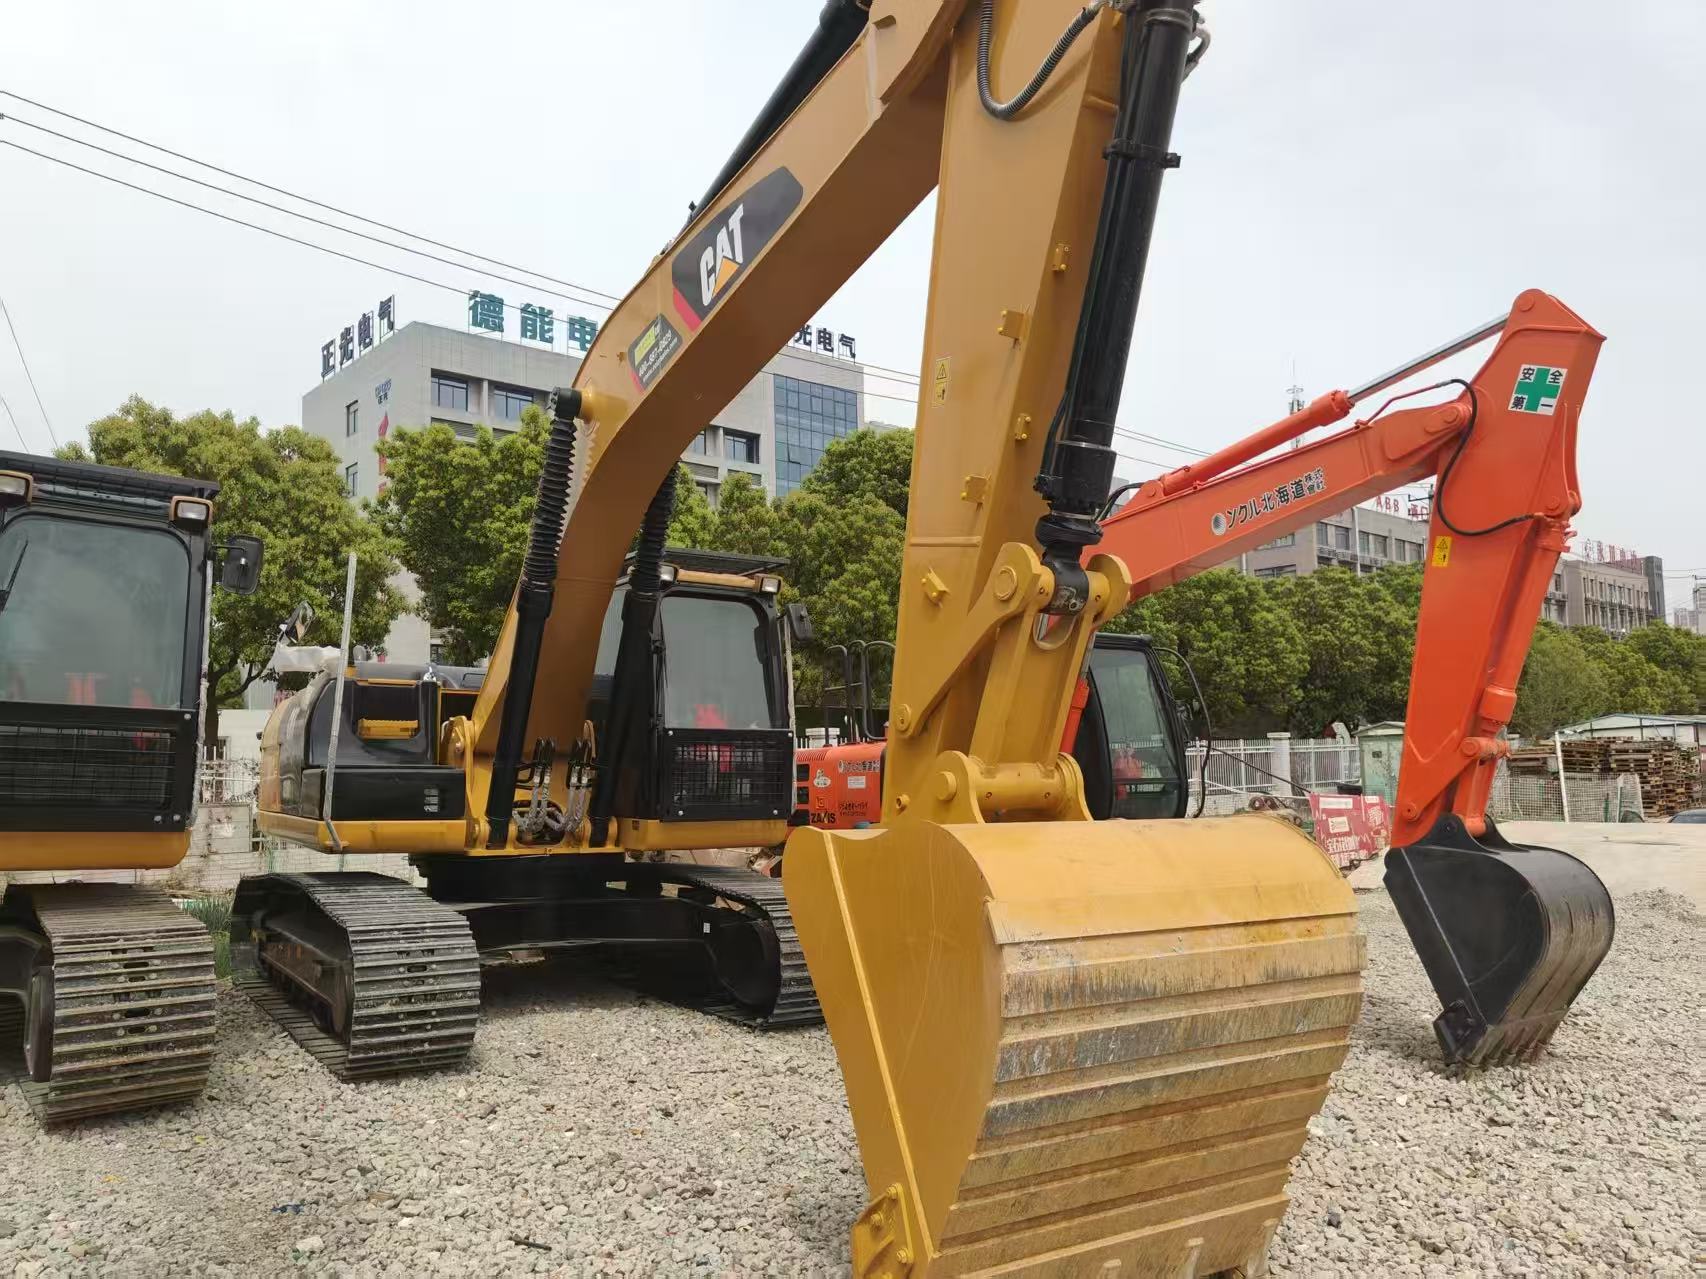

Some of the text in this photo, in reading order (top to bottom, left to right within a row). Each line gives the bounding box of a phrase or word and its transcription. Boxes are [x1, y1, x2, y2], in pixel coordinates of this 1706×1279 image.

[699, 203, 744, 306] CAT
[321, 296, 394, 377] 正光电气
[1519, 367, 1563, 384] 安全
[1511, 395, 1554, 410] 第一
[1376, 495, 1399, 512] ABB
